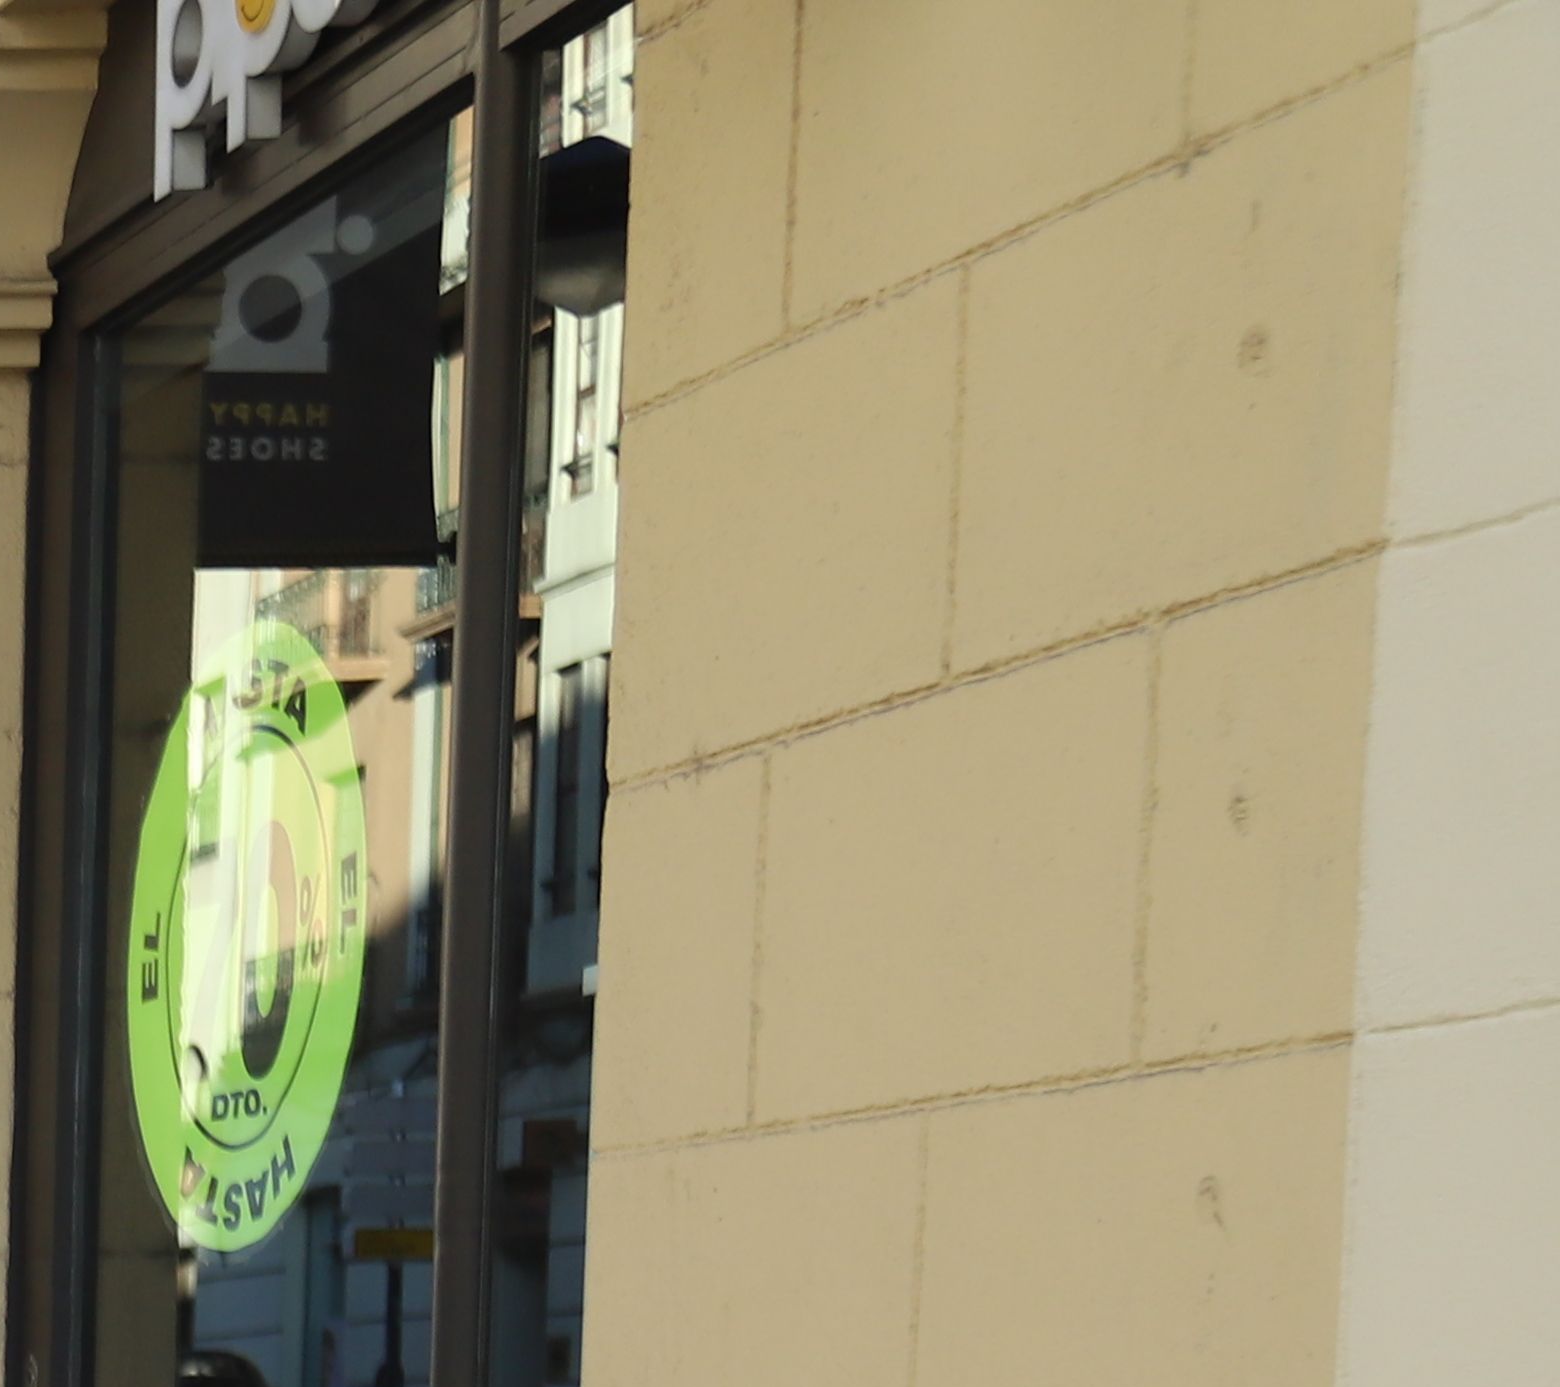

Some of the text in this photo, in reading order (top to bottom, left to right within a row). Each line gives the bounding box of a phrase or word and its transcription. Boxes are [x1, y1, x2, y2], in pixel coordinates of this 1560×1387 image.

[340, 852, 358, 955] EL
[141, 911, 162, 1003] EL
[210, 1089, 268, 1122] DTO.
[180, 1134, 296, 1232] HASTA
